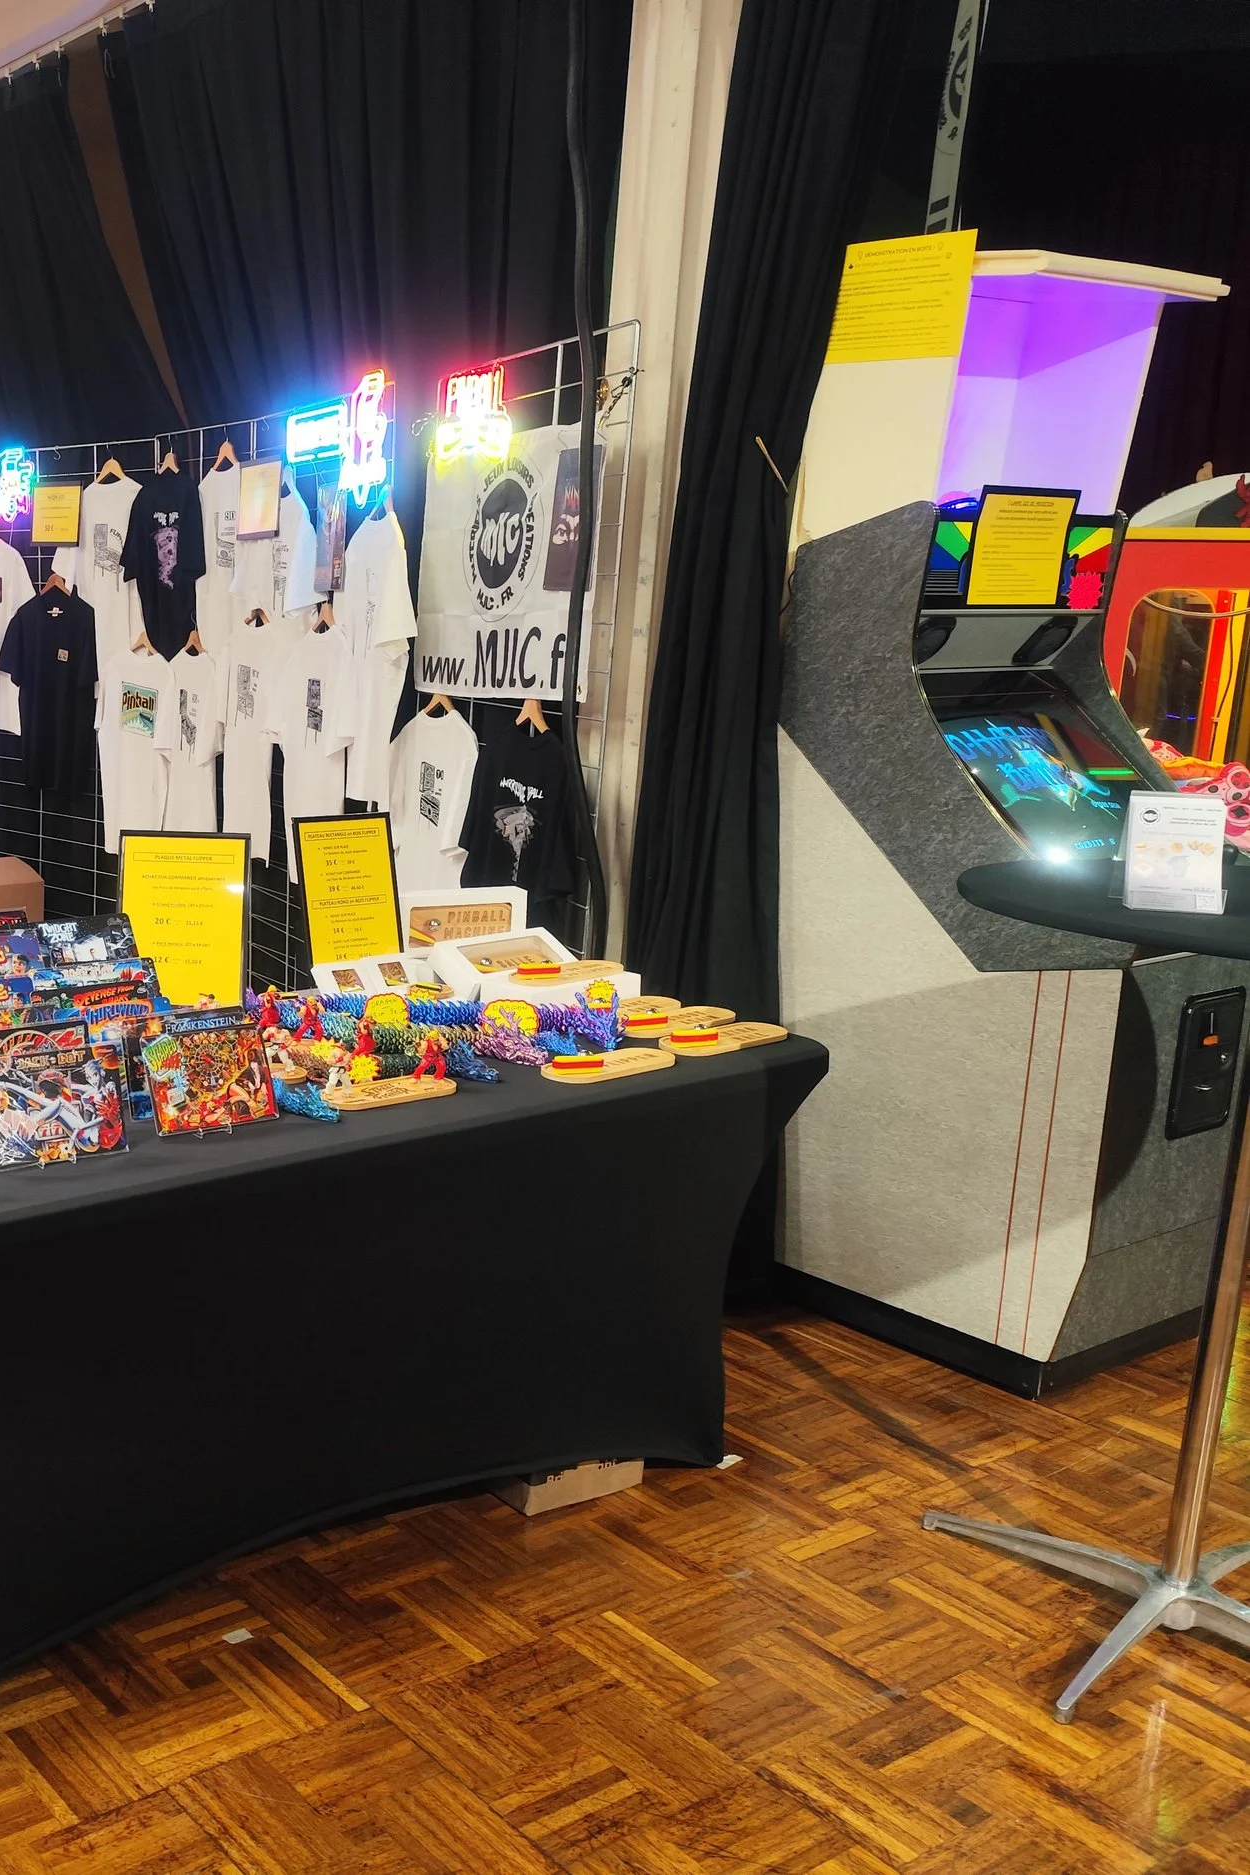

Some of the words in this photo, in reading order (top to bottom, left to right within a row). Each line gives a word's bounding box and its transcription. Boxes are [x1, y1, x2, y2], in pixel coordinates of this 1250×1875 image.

[122, 690, 154, 712] Pinball
[447, 910, 506, 923] PINBALL
[50, 933, 75, 943] ZONE
[73, 986, 116, 1006] REVENGE
[165, 1016, 236, 1034] FRANKENSTEIN
